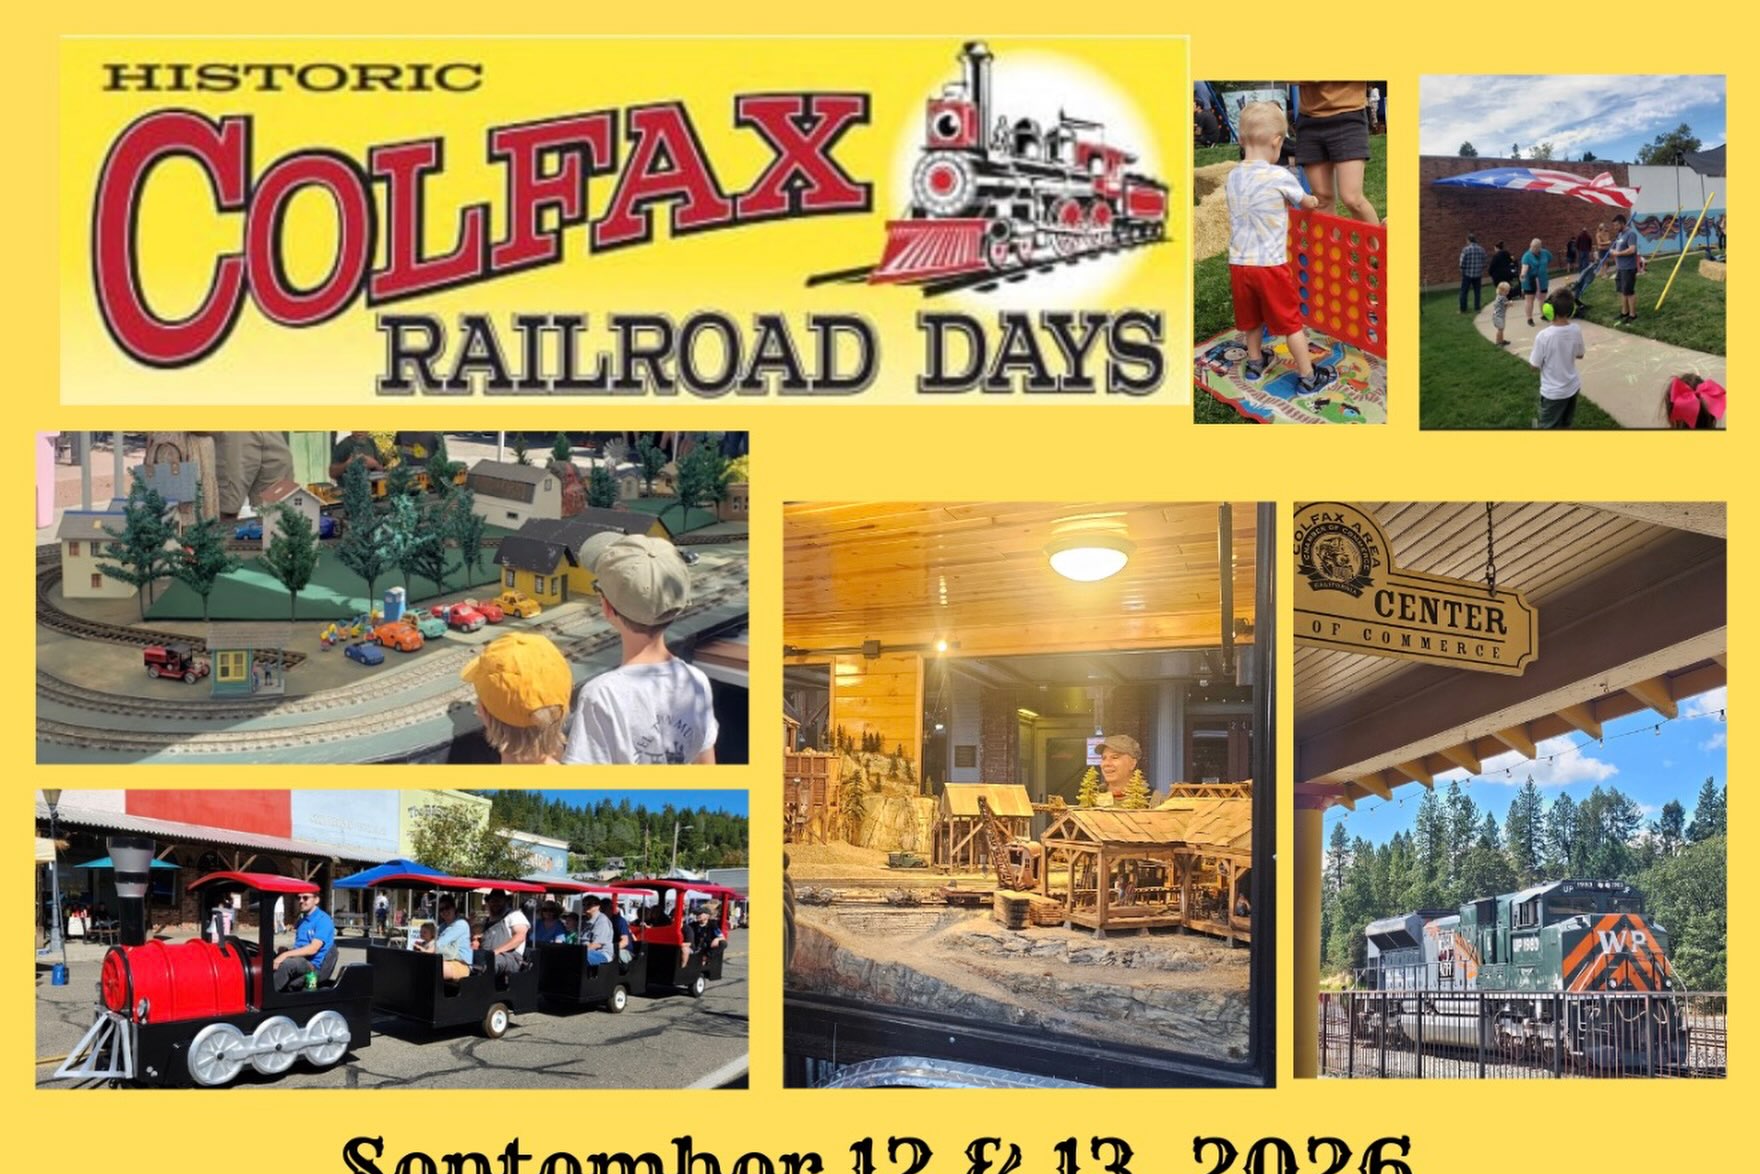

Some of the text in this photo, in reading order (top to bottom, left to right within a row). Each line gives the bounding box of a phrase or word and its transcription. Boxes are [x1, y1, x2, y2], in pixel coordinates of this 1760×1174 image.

[103, 63, 483, 92] HISTORIC
[91, 92, 875, 371] COLFAX
[376, 309, 1168, 398] RAILROAD DAYS
[1293, 512, 1381, 568] COLFAX AREA
[1374, 589, 1508, 635] CENTER
[1312, 620, 1501, 659] OF COMMERCE
[1597, 930, 1646, 954] WP
